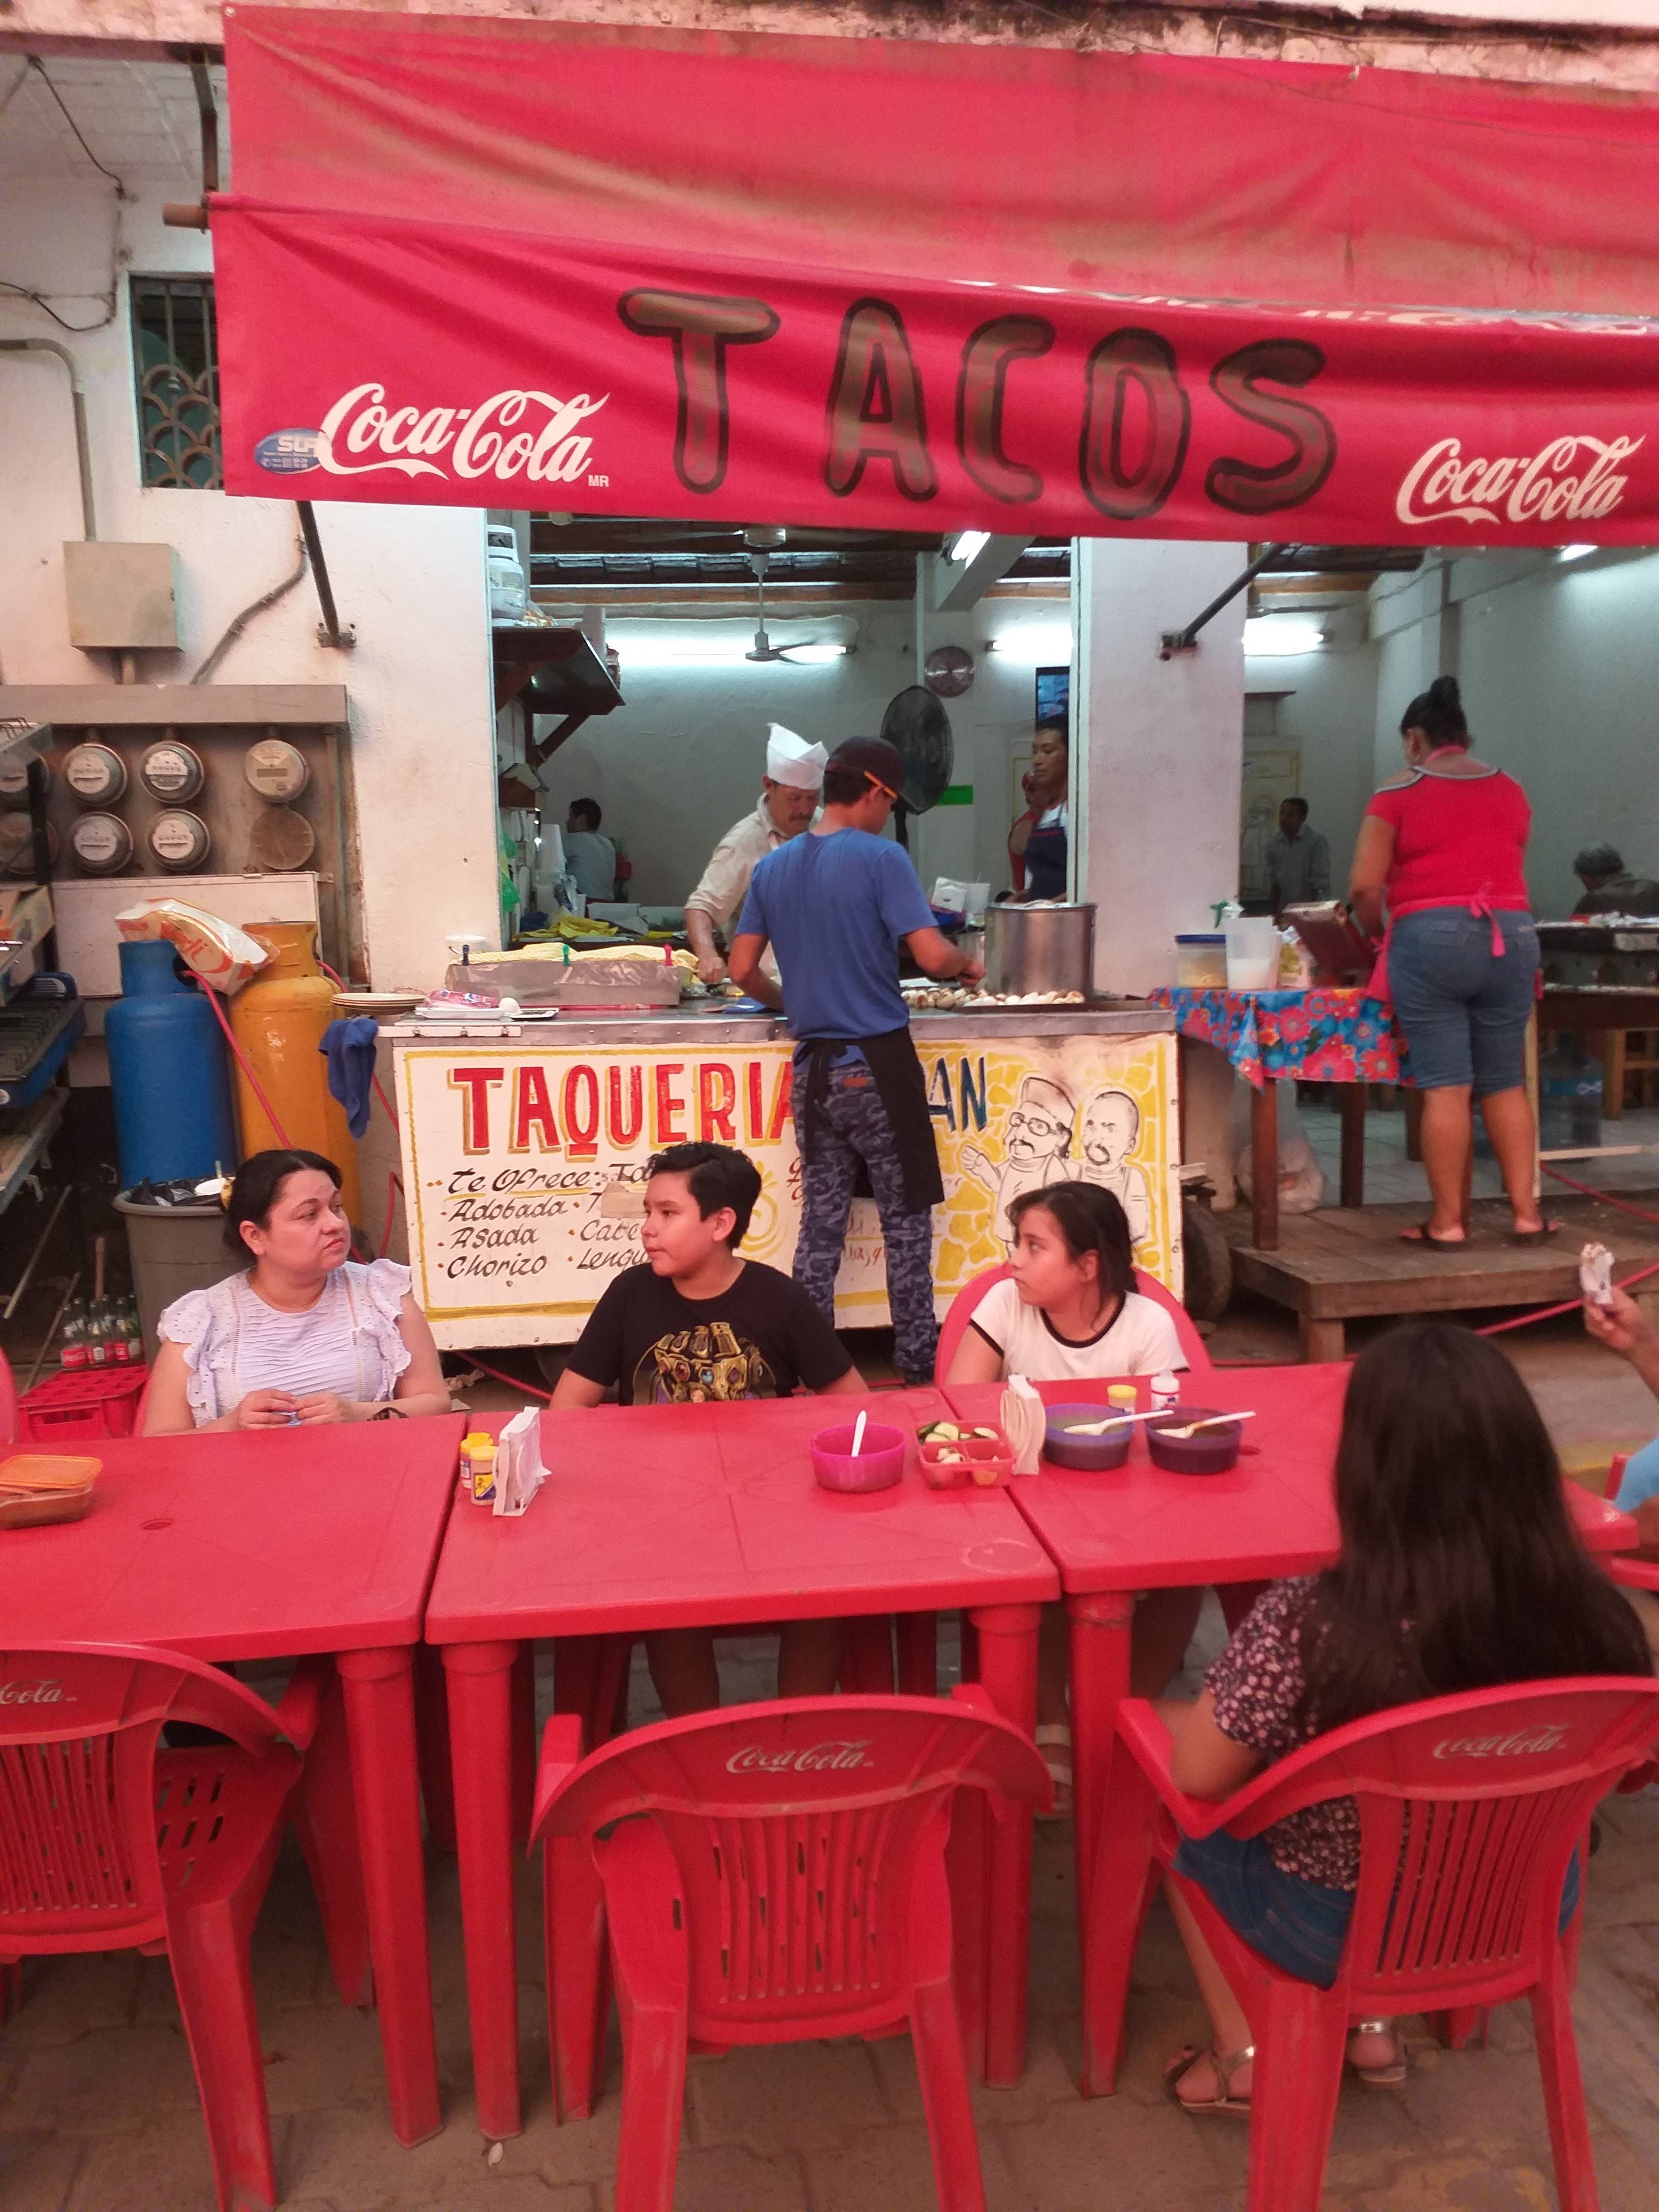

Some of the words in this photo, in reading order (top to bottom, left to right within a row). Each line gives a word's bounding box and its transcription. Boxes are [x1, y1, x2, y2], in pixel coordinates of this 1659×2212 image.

[617, 288, 1337, 518] TACOS
[317, 383, 611, 482] Coca-Cola
[588, 474, 610, 488] MR
[1395, 433, 1647, 525] Coca-Cola
[447, 1196, 569, 1222] Adobada
[449, 1223, 540, 1250] Asada
[447, 1252, 548, 1279] Chorizo
